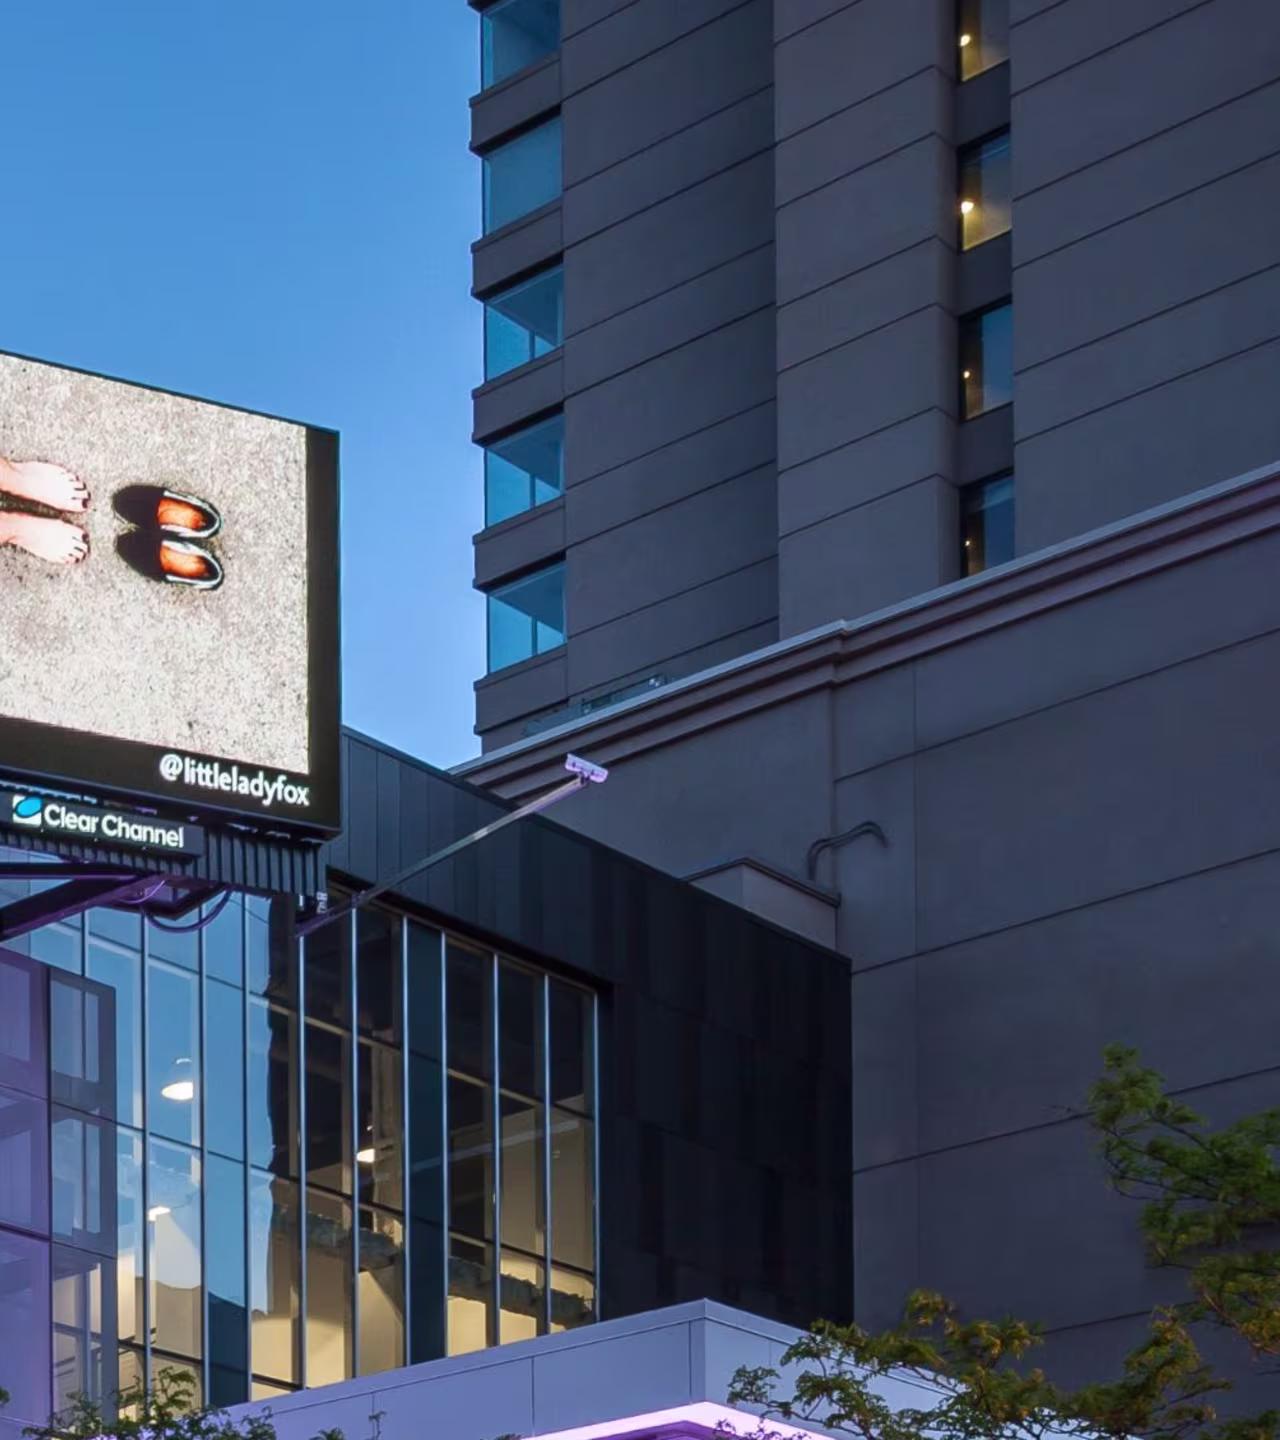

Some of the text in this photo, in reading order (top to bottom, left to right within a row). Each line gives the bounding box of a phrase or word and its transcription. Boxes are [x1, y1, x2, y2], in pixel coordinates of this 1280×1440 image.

[158, 753, 310, 807] @littleladyfox
[43, 802, 185, 849] Clear Channel
